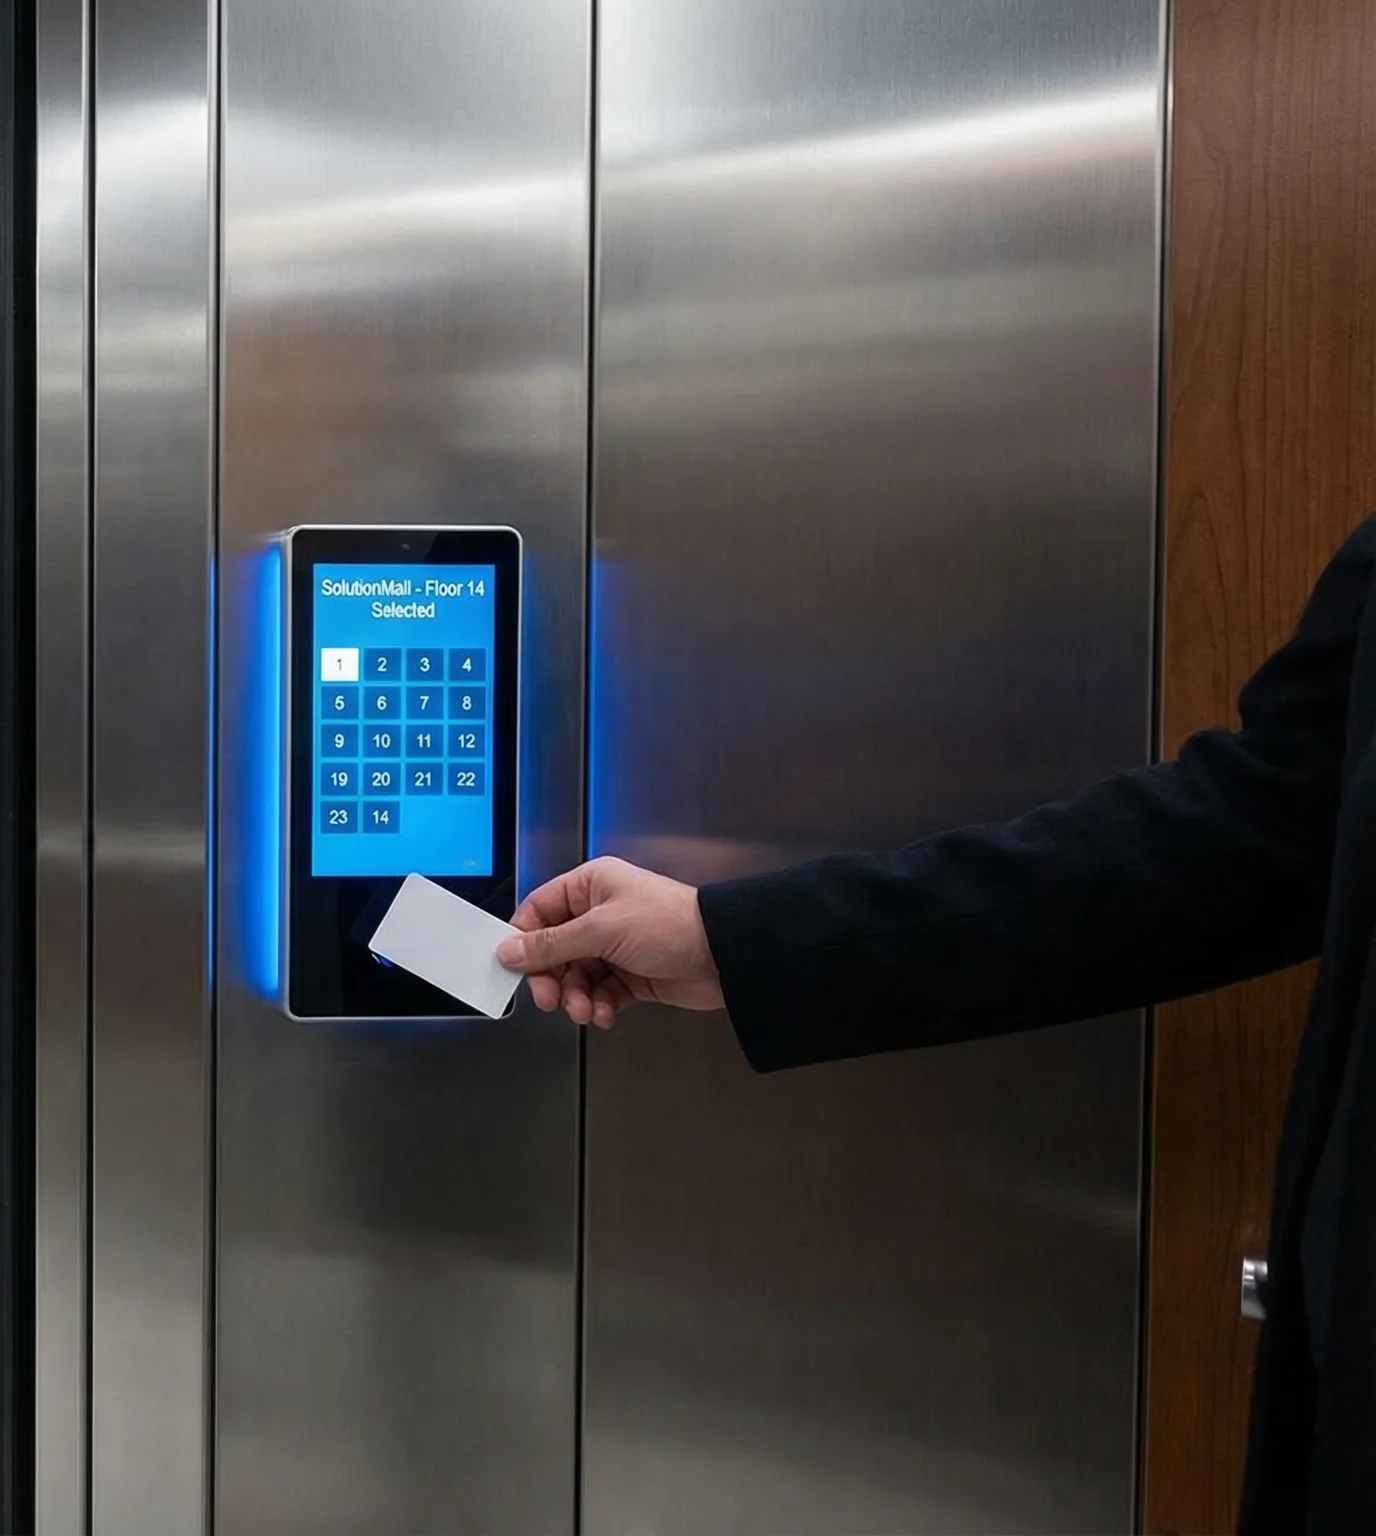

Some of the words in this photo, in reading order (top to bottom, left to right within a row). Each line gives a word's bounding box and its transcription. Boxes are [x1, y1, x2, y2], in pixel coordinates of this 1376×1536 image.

[321, 578, 412, 597] SolutionMall
[425, 579, 464, 597] Floor
[467, 580, 485, 597] 14
[371, 601, 436, 619] Selected
[335, 657, 343, 672] 1
[377, 656, 387, 672] 2
[419, 657, 430, 673] 3
[462, 657, 472, 672] 4
[334, 695, 345, 711] 5
[376, 695, 387, 711] 6
[419, 695, 430, 710] 7
[461, 695, 472, 711] 8
[334, 733, 345, 749] 9
[372, 733, 391, 749] 10
[416, 733, 431, 748] 11
[458, 733, 476, 749] 12
[330, 771, 349, 787] 19
[372, 771, 391, 787] 20
[414, 771, 431, 787] 21
[457, 771, 476, 787] 22
[329, 809, 349, 825] 23
[372, 810, 390, 825] 14
